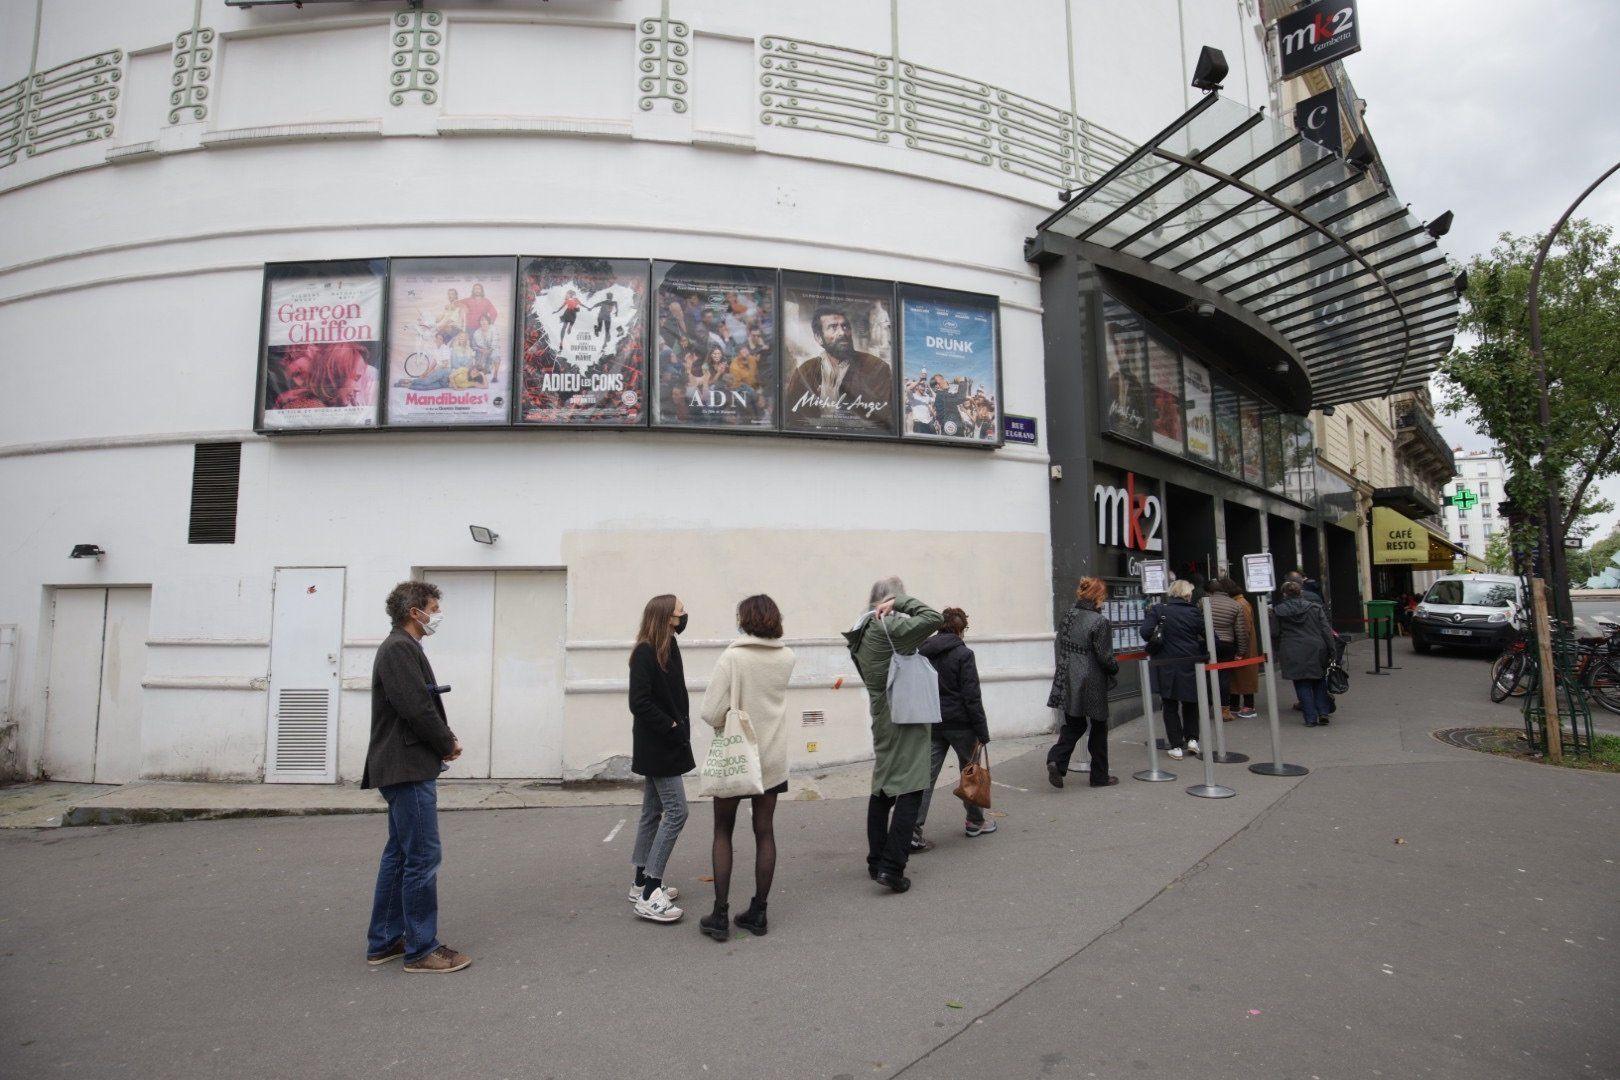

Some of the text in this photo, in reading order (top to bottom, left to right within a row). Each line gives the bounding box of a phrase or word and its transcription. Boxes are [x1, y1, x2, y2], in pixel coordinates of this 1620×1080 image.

[1282, 7, 1353, 55] mk2
[1313, 31, 1351, 53] Gambetta
[288, 320, 372, 343] Chiffon
[926, 336, 974, 353] DRUNK
[541, 373, 624, 392] ADIEU LES CONS
[689, 389, 748, 408] ADN
[1005, 429, 1035, 440] ELGRAND
[1011, 421, 1025, 430] RUE
[1094, 471, 1162, 552] mk2
[1389, 527, 1412, 539] CAFÉ
[1386, 541, 1416, 550] RESTO
